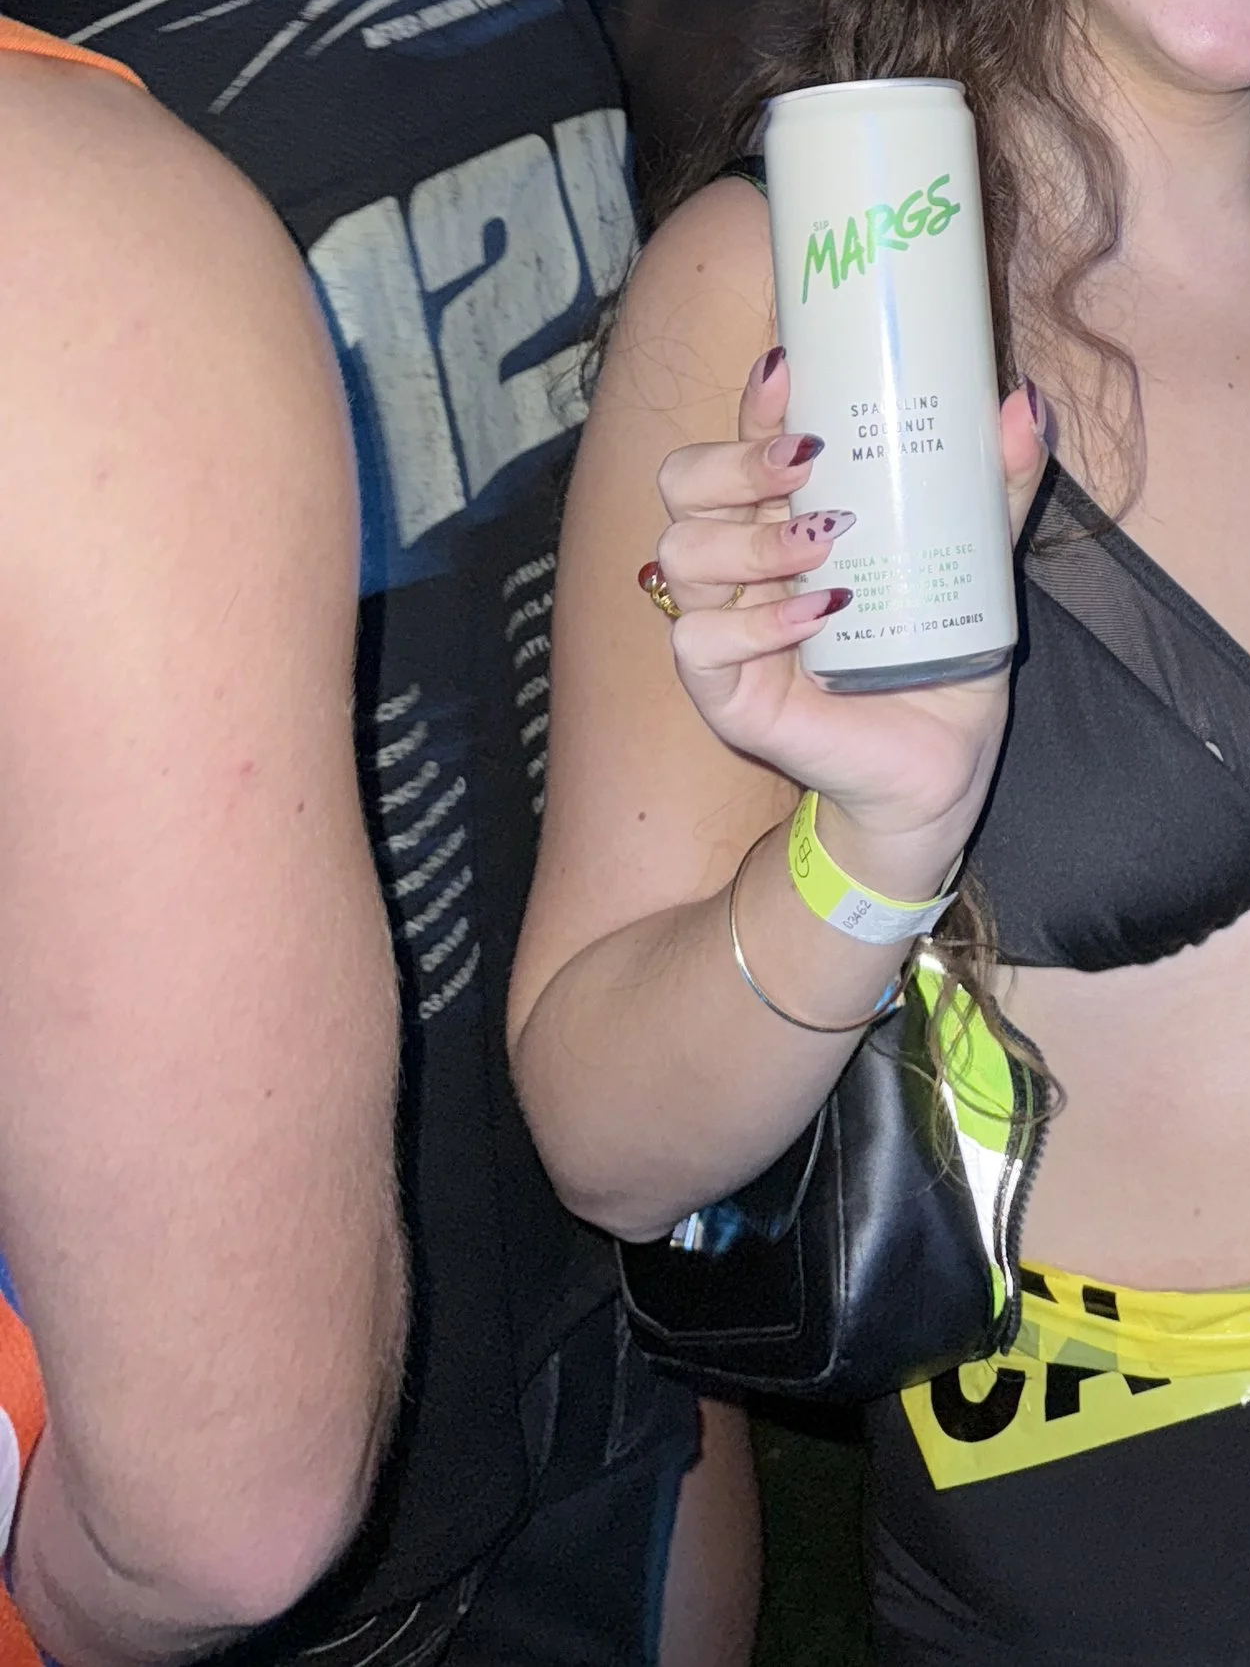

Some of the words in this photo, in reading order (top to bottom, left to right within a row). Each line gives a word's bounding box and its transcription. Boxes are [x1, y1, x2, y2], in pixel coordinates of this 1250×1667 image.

[813, 220, 829, 232] SIP
[802, 173, 961, 305] MARGS
[851, 395, 938, 417] SPALING
[852, 438, 944, 462] MARARITA
[833, 556, 875, 570] TEQUILA
[939, 560, 959, 573] AND
[953, 573, 973, 585] AND
[836, 631, 851, 642] 5%
[854, 629, 875, 640] ALC.
[921, 620, 938, 632] 120
[942, 612, 984, 629] CALORIES
[842, 899, 872, 930] 03462
